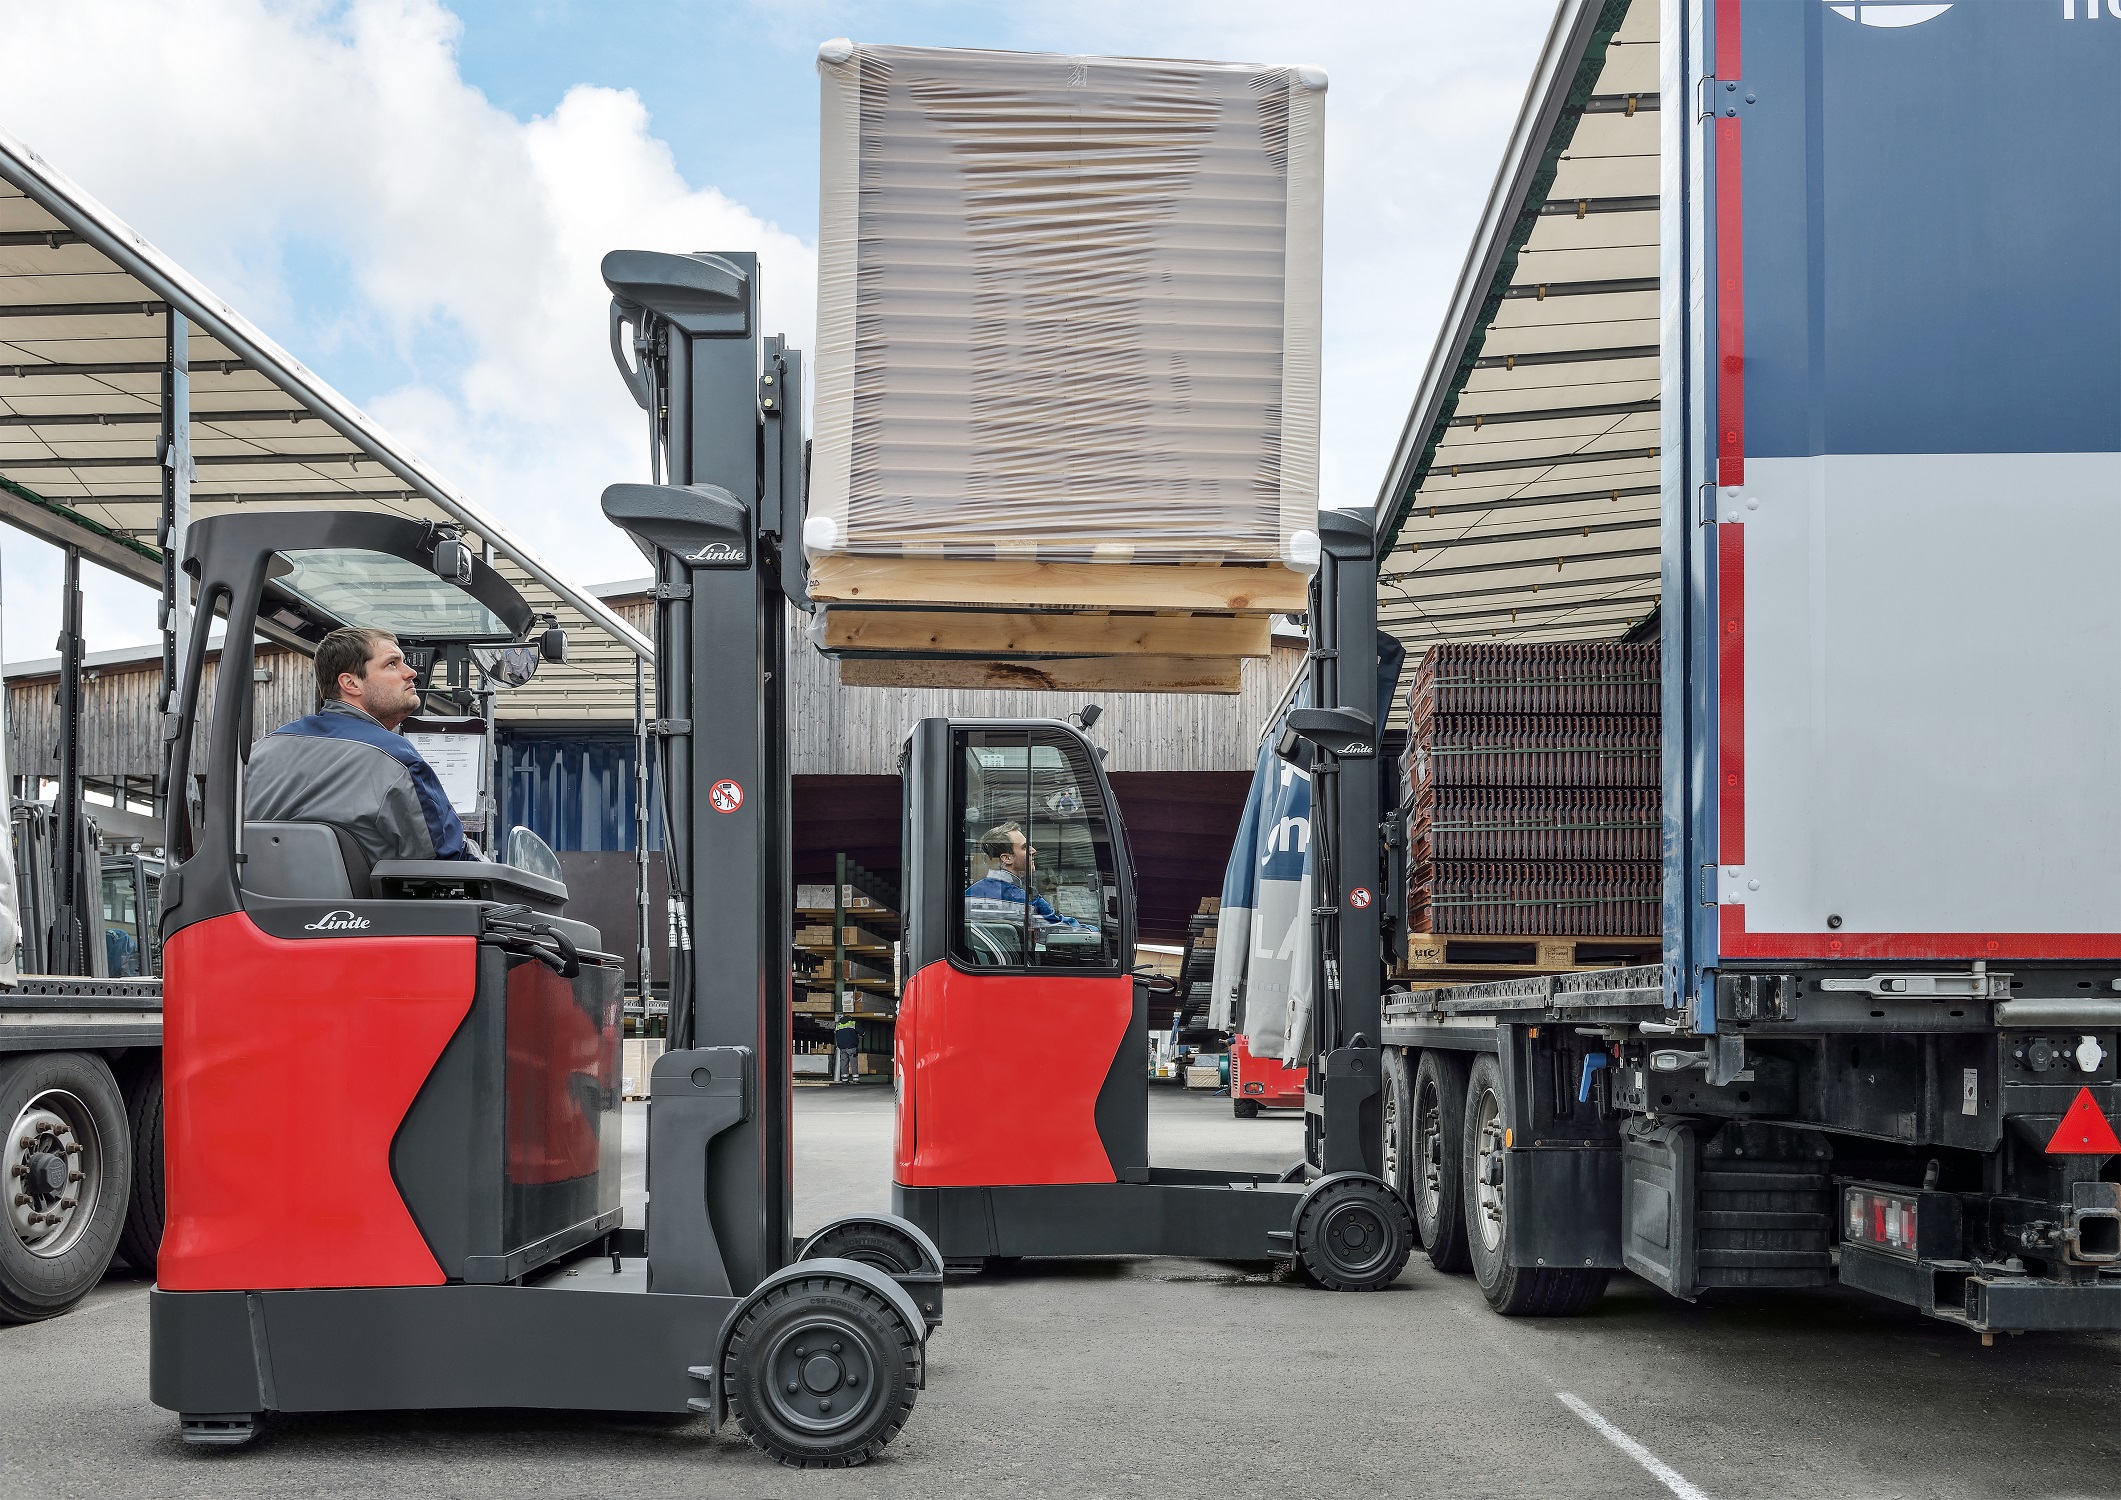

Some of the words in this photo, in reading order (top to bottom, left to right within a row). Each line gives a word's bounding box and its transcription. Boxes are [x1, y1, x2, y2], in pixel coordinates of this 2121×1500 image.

[686, 542, 744, 560] Linde
[1337, 742, 1373, 754] Linde
[304, 910, 371, 930] Linde
